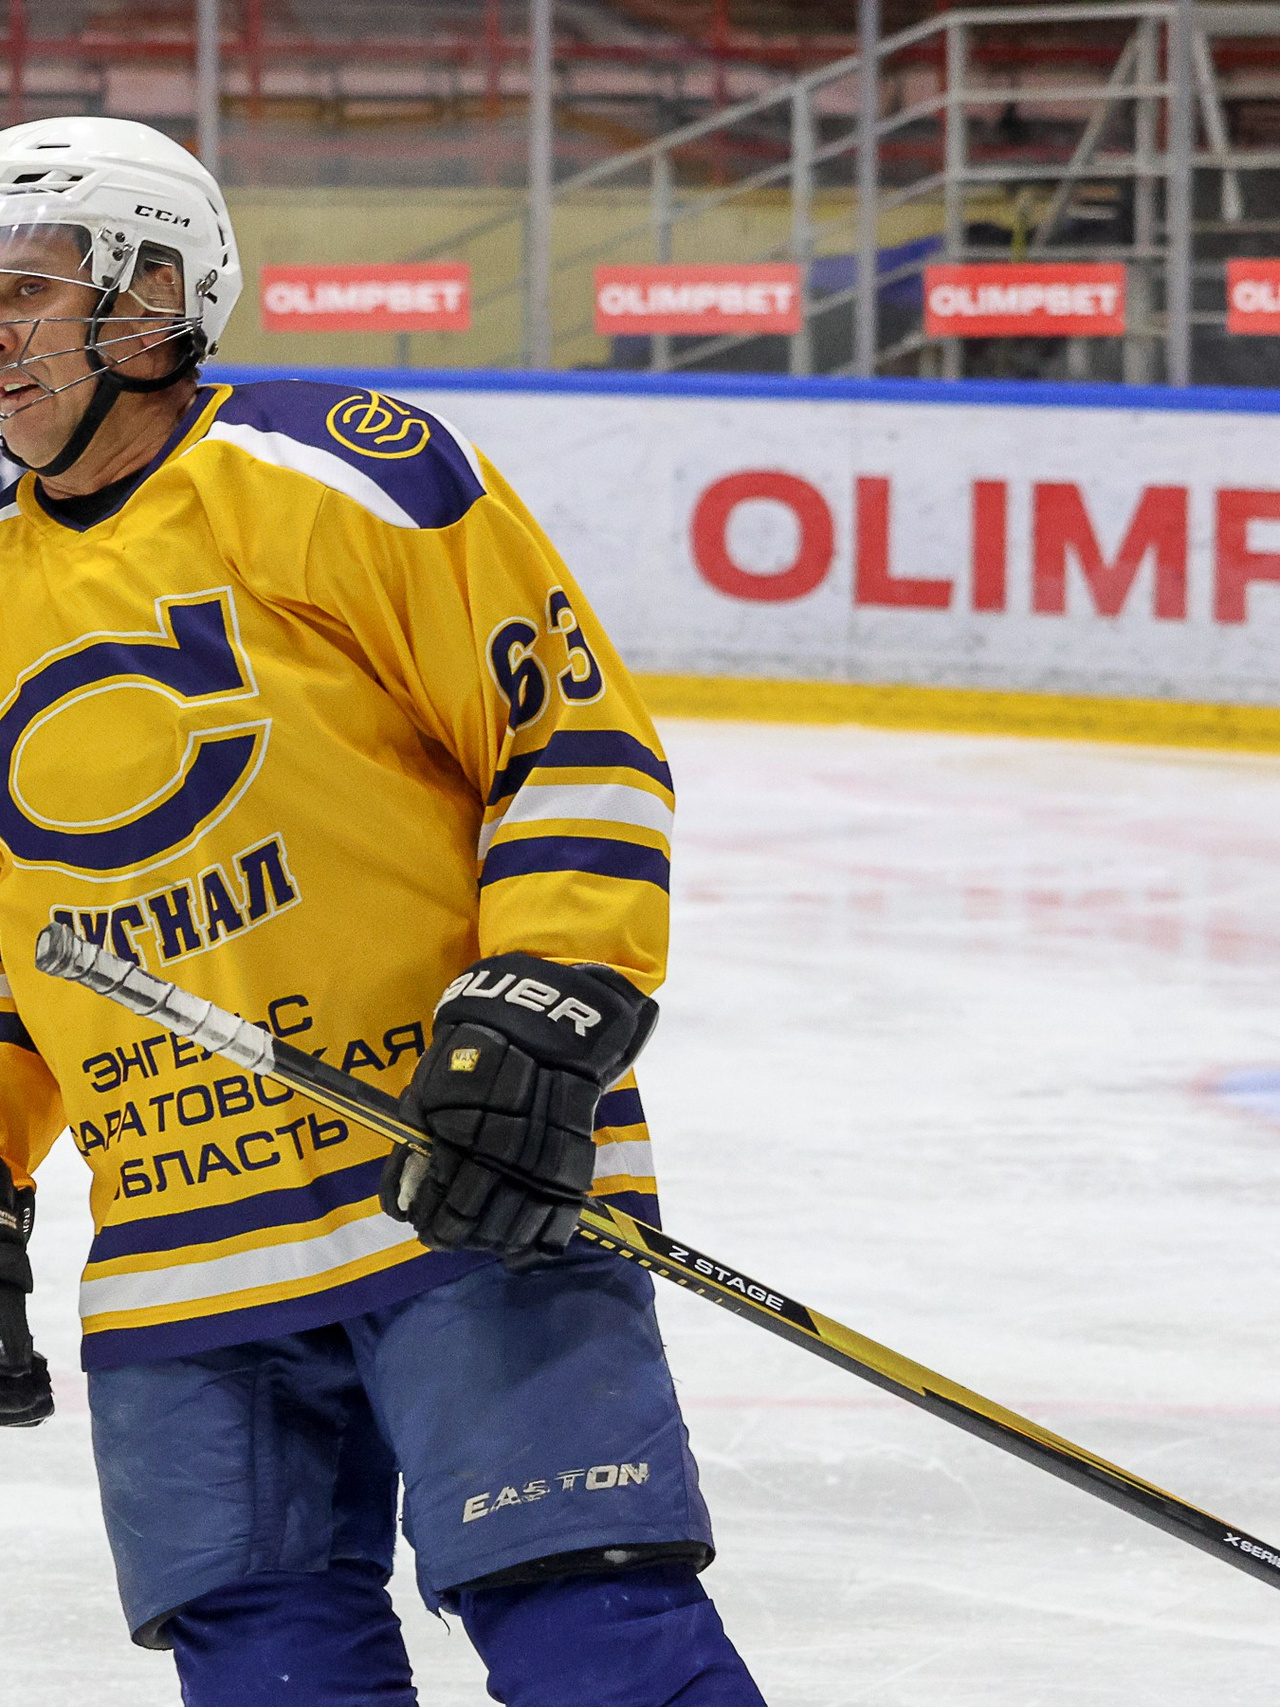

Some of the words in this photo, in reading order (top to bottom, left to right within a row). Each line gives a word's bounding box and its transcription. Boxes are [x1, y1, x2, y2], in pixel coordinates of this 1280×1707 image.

[134, 204, 191, 228] CCM
[265, 280, 462, 315] OLIMPBET
[598, 281, 793, 316] OLIMPBET
[928, 283, 1117, 317] OLIMPBET
[1232, 279, 1280, 313] OL
[485, 584, 606, 737] 63
[433, 969, 602, 1037] AUER
[81, 994, 314, 1093] ЭНГЕС
[69, 1020, 427, 1158] АРАТОВСАЯ
[112, 1111, 351, 1201] БЛАСТЬ
[668, 1245, 690, 1264] Z
[694, 1258, 784, 1312] STAGE
[462, 1462, 651, 1523] EASTON
[1240, 1540, 1280, 1569] SERI
